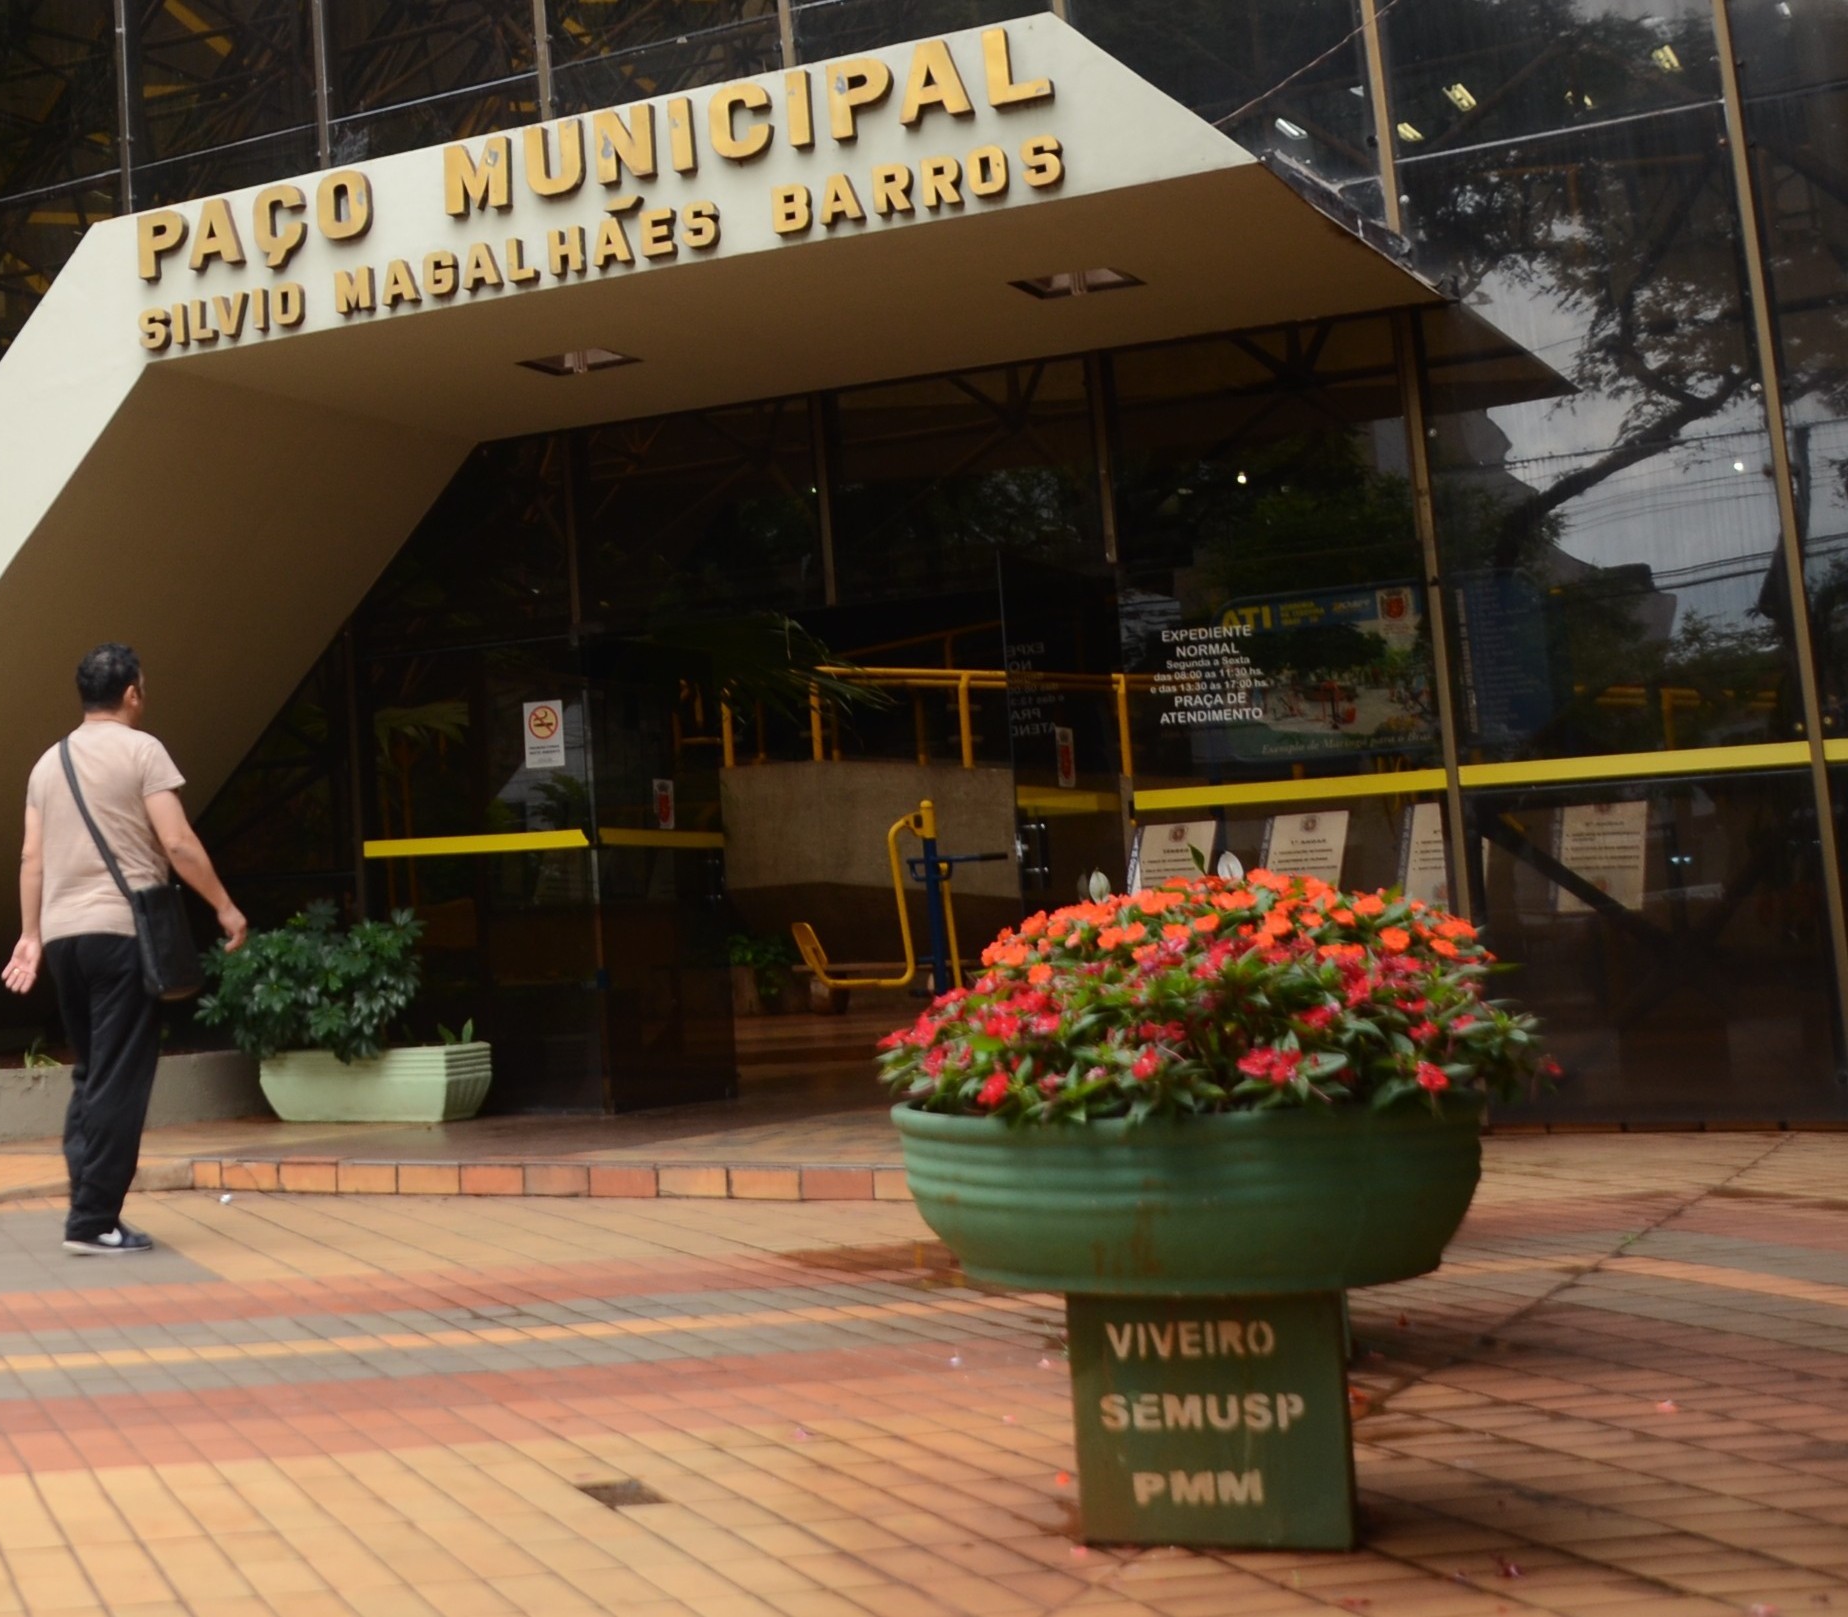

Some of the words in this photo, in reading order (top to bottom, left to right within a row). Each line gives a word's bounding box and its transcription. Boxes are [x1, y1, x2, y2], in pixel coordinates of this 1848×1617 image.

[136, 169, 374, 282] PAÇO
[443, 27, 1056, 219] MUNICIPAL
[138, 281, 306, 353] SILVIO
[333, 196, 721, 316] MAGALHÃES
[770, 134, 1065, 238] BARROS
[1221, 604, 1273, 631] ATI
[1161, 624, 1252, 643] EXPEDIENTE
[1175, 642, 1240, 658] NORMAL
[1166, 658, 1211, 670] Segunda
[1222, 656, 1251, 665] Sexta
[1153, 672, 1172, 682] das
[1174, 670, 1202, 681] 08:00
[1219, 667, 1247, 677] 11:30
[1150, 686, 1156, 694] e
[1158, 683, 1177, 693] das
[1180, 681, 1207, 692] 13:30
[1225, 678, 1252, 689] 17:00
[1174, 693, 1224, 708] PRAÇA
[1227, 692, 1247, 704] DE
[1160, 707, 1263, 725] ATENDIMENTO
[1105, 1320, 1275, 1360] VIVEIRO
[1100, 1393, 1305, 1432] SEMUSP
[1132, 1469, 1265, 1506] PMM
